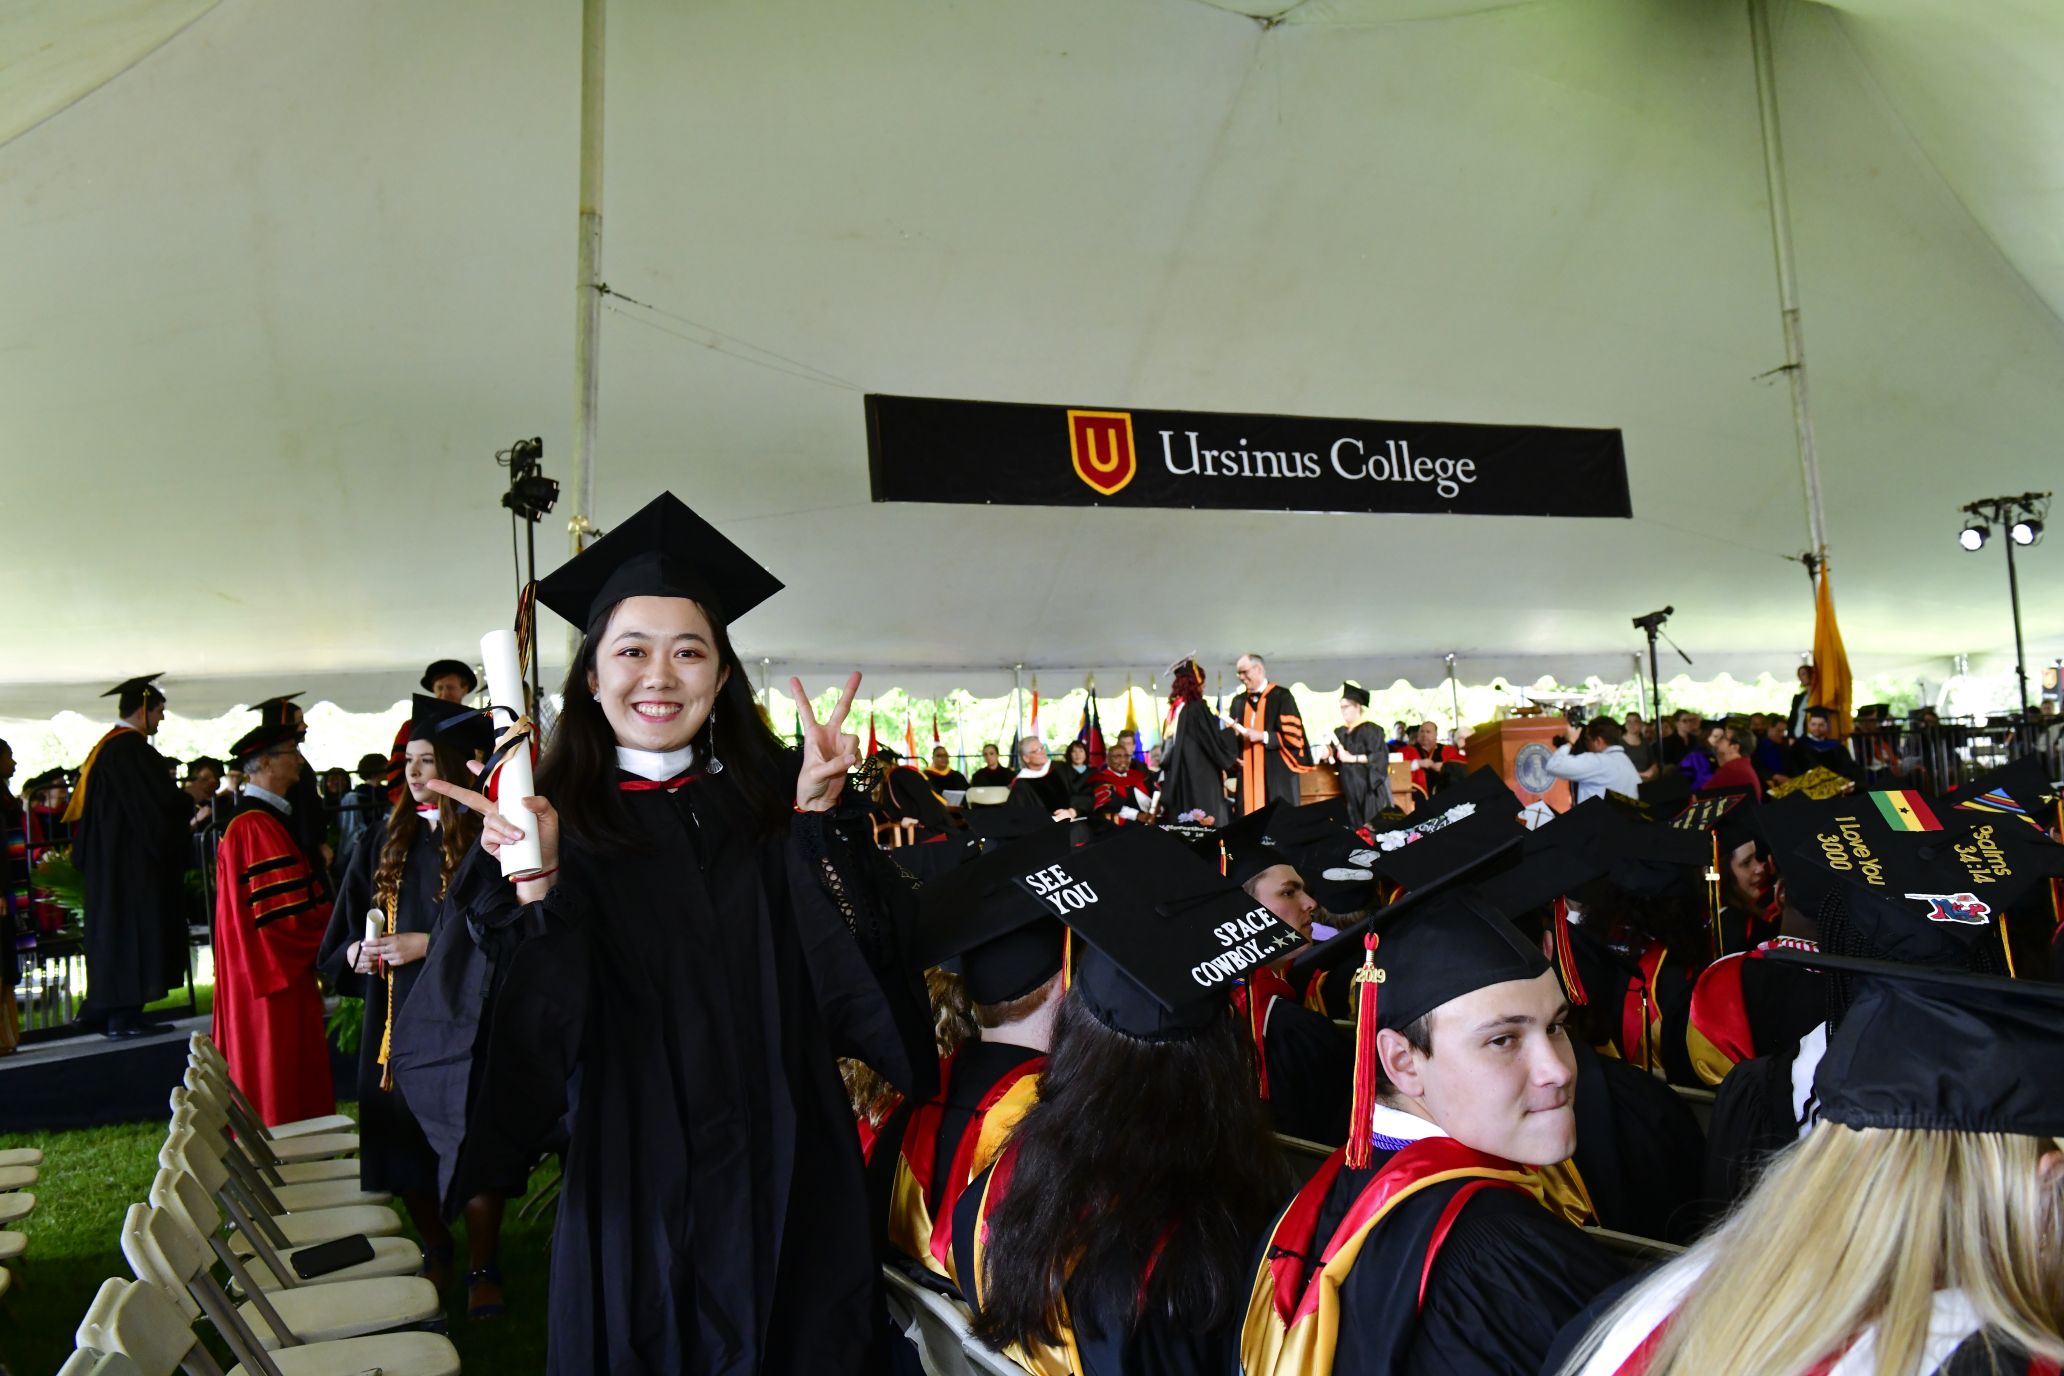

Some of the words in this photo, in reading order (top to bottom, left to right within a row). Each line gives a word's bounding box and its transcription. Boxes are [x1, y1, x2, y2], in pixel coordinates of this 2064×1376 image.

[1087, 427, 1118, 473] U
[1158, 430, 1321, 478] Ursinus
[1330, 437, 1477, 498] College
[1816, 833, 1853, 870] 3000
[1839, 824, 1871, 858] Love
[1858, 858, 1886, 885] You
[1953, 844, 1996, 884] 34:14
[1025, 864, 1074, 896] SEE
[1046, 881, 1099, 915] YOU
[1213, 908, 1278, 947] SPACE
[1355, 967, 1387, 984] 2019
